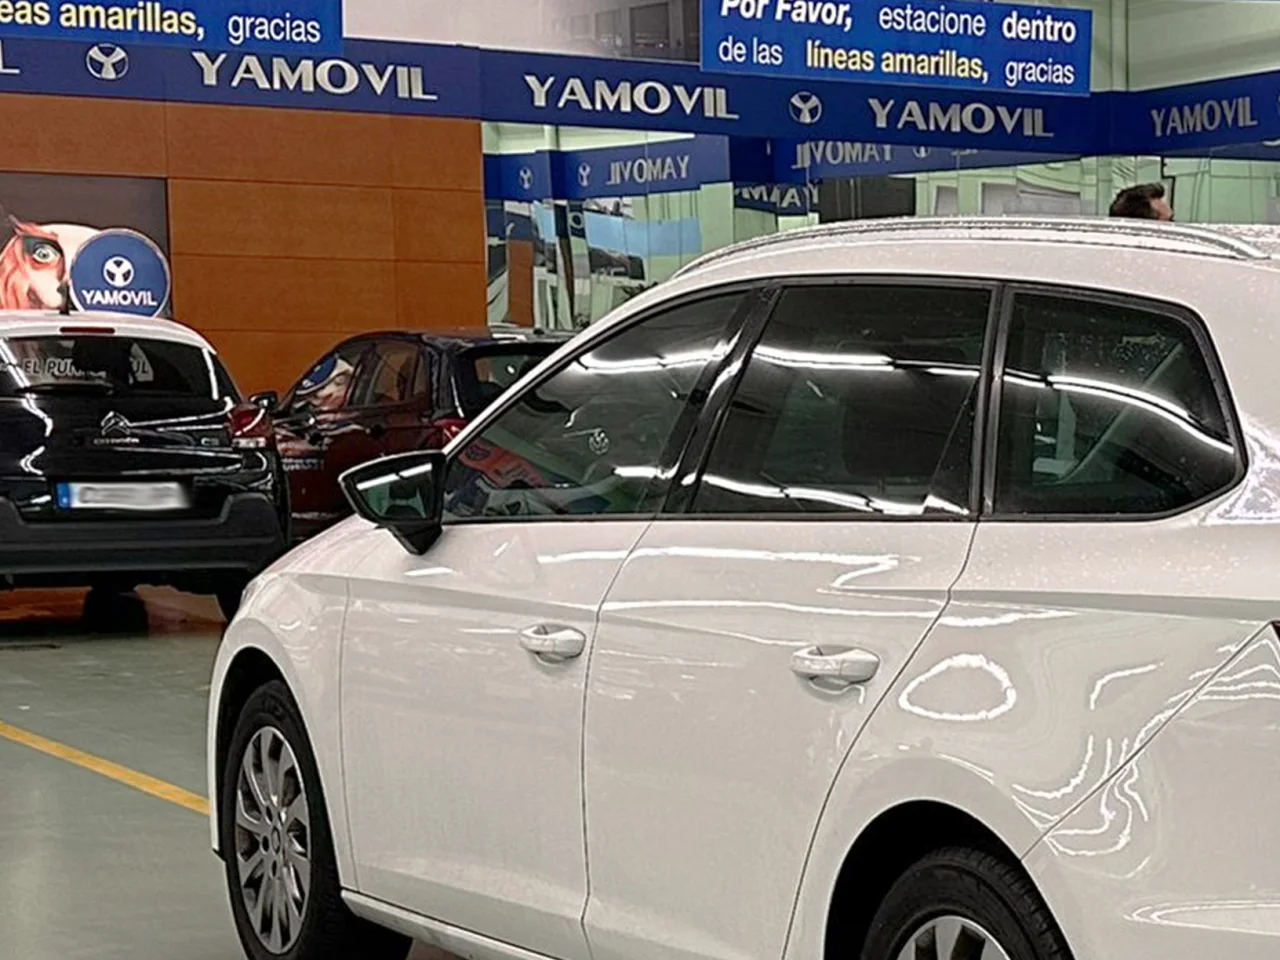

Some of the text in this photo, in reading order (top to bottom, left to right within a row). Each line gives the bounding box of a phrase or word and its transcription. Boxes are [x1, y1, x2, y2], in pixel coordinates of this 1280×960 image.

[59, 2, 205, 40] amarillas,
[227, 13, 321, 44] gracias
[720, 0, 1076, 43] Por Favor, estacione dentro
[192, 51, 438, 100] YAMOVIL
[719, 36, 1075, 87] de las líneas amarillas, gracias
[524, 75, 739, 120] YAMOVIL
[868, 97, 1054, 137] YAMOVIL
[1151, 96, 1257, 138] YAMOVIL
[82, 289, 157, 307] YAMOVIL
